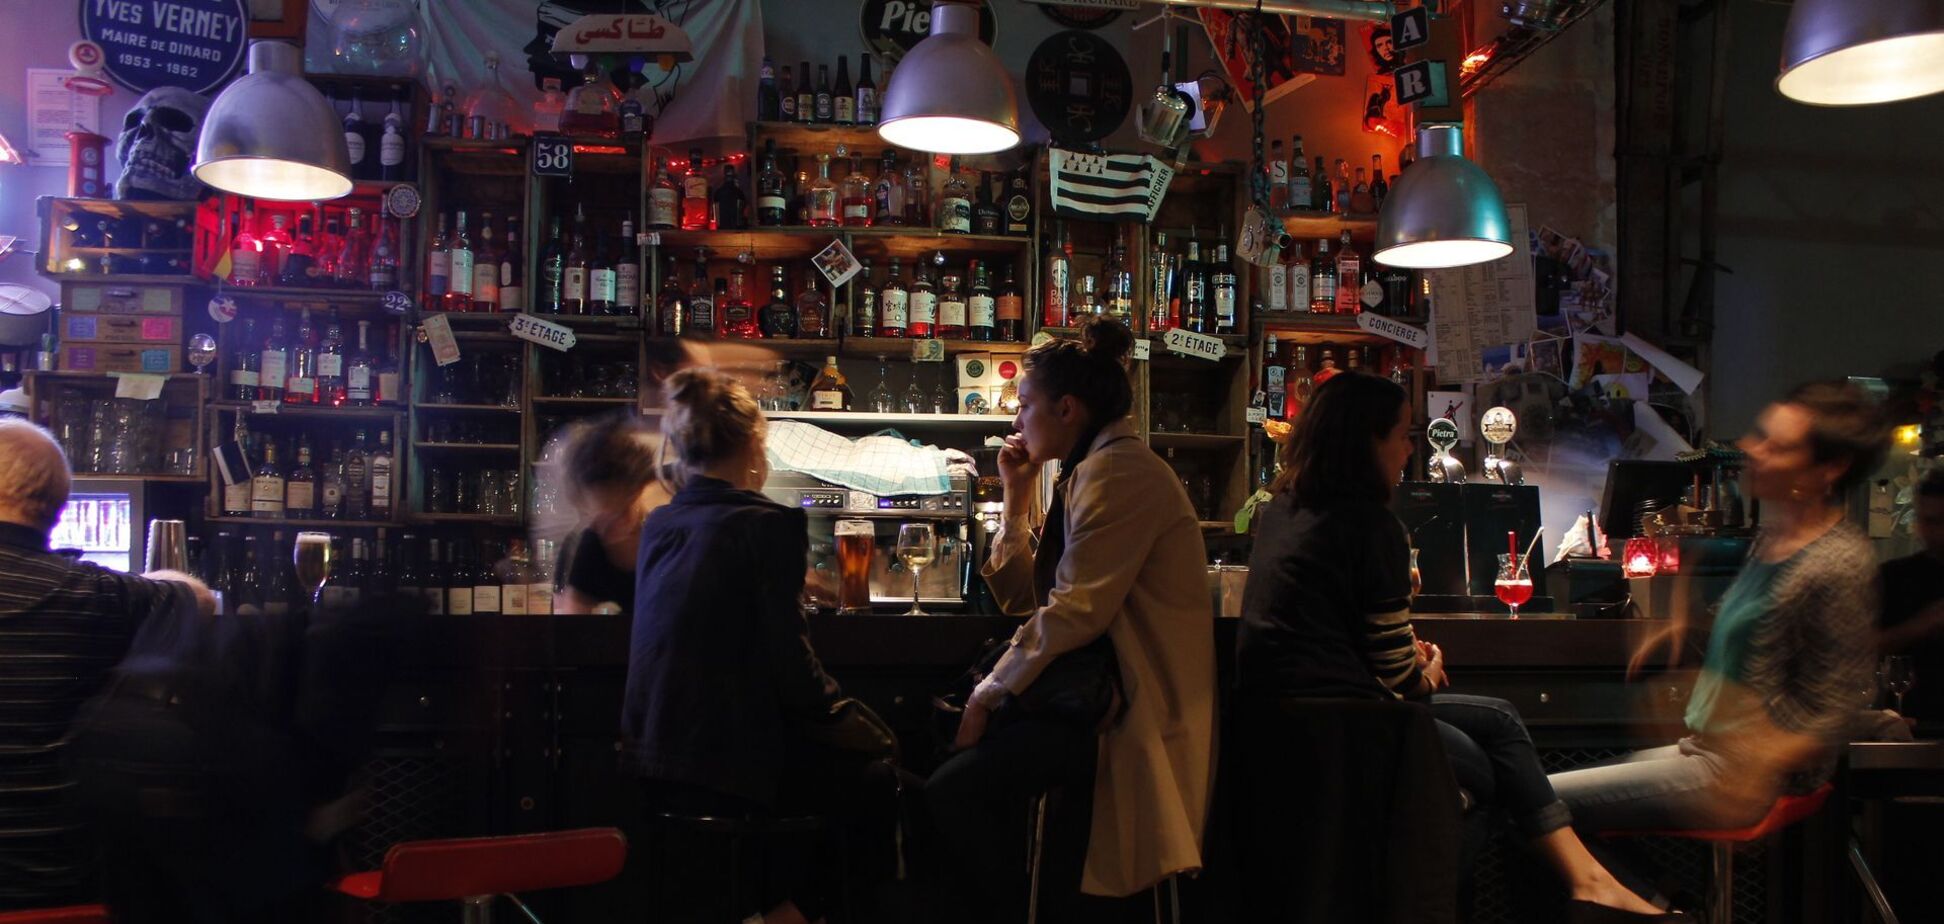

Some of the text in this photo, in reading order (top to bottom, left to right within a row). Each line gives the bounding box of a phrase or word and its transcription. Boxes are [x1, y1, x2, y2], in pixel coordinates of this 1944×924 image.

[95, 0, 238, 43] YVES VERNEY
[880, 0, 930, 33] Pie
[1399, 15, 1422, 44] A
[101, 28, 148, 48] MAIRE
[169, 41, 221, 62] DINARD
[119, 53, 151, 68] 1953
[166, 62, 198, 78] 1962
[1400, 69, 1426, 98] R
[537, 142, 569, 169] 58
[1147, 168, 1169, 218] AFFICHER
[384, 294, 405, 311] 22
[530, 321, 567, 345] ÉTAGE
[1369, 316, 1419, 342] CONCIERGE
[1185, 334, 1219, 355] ÉTAGE
[1432, 428, 1455, 438] Pietra
